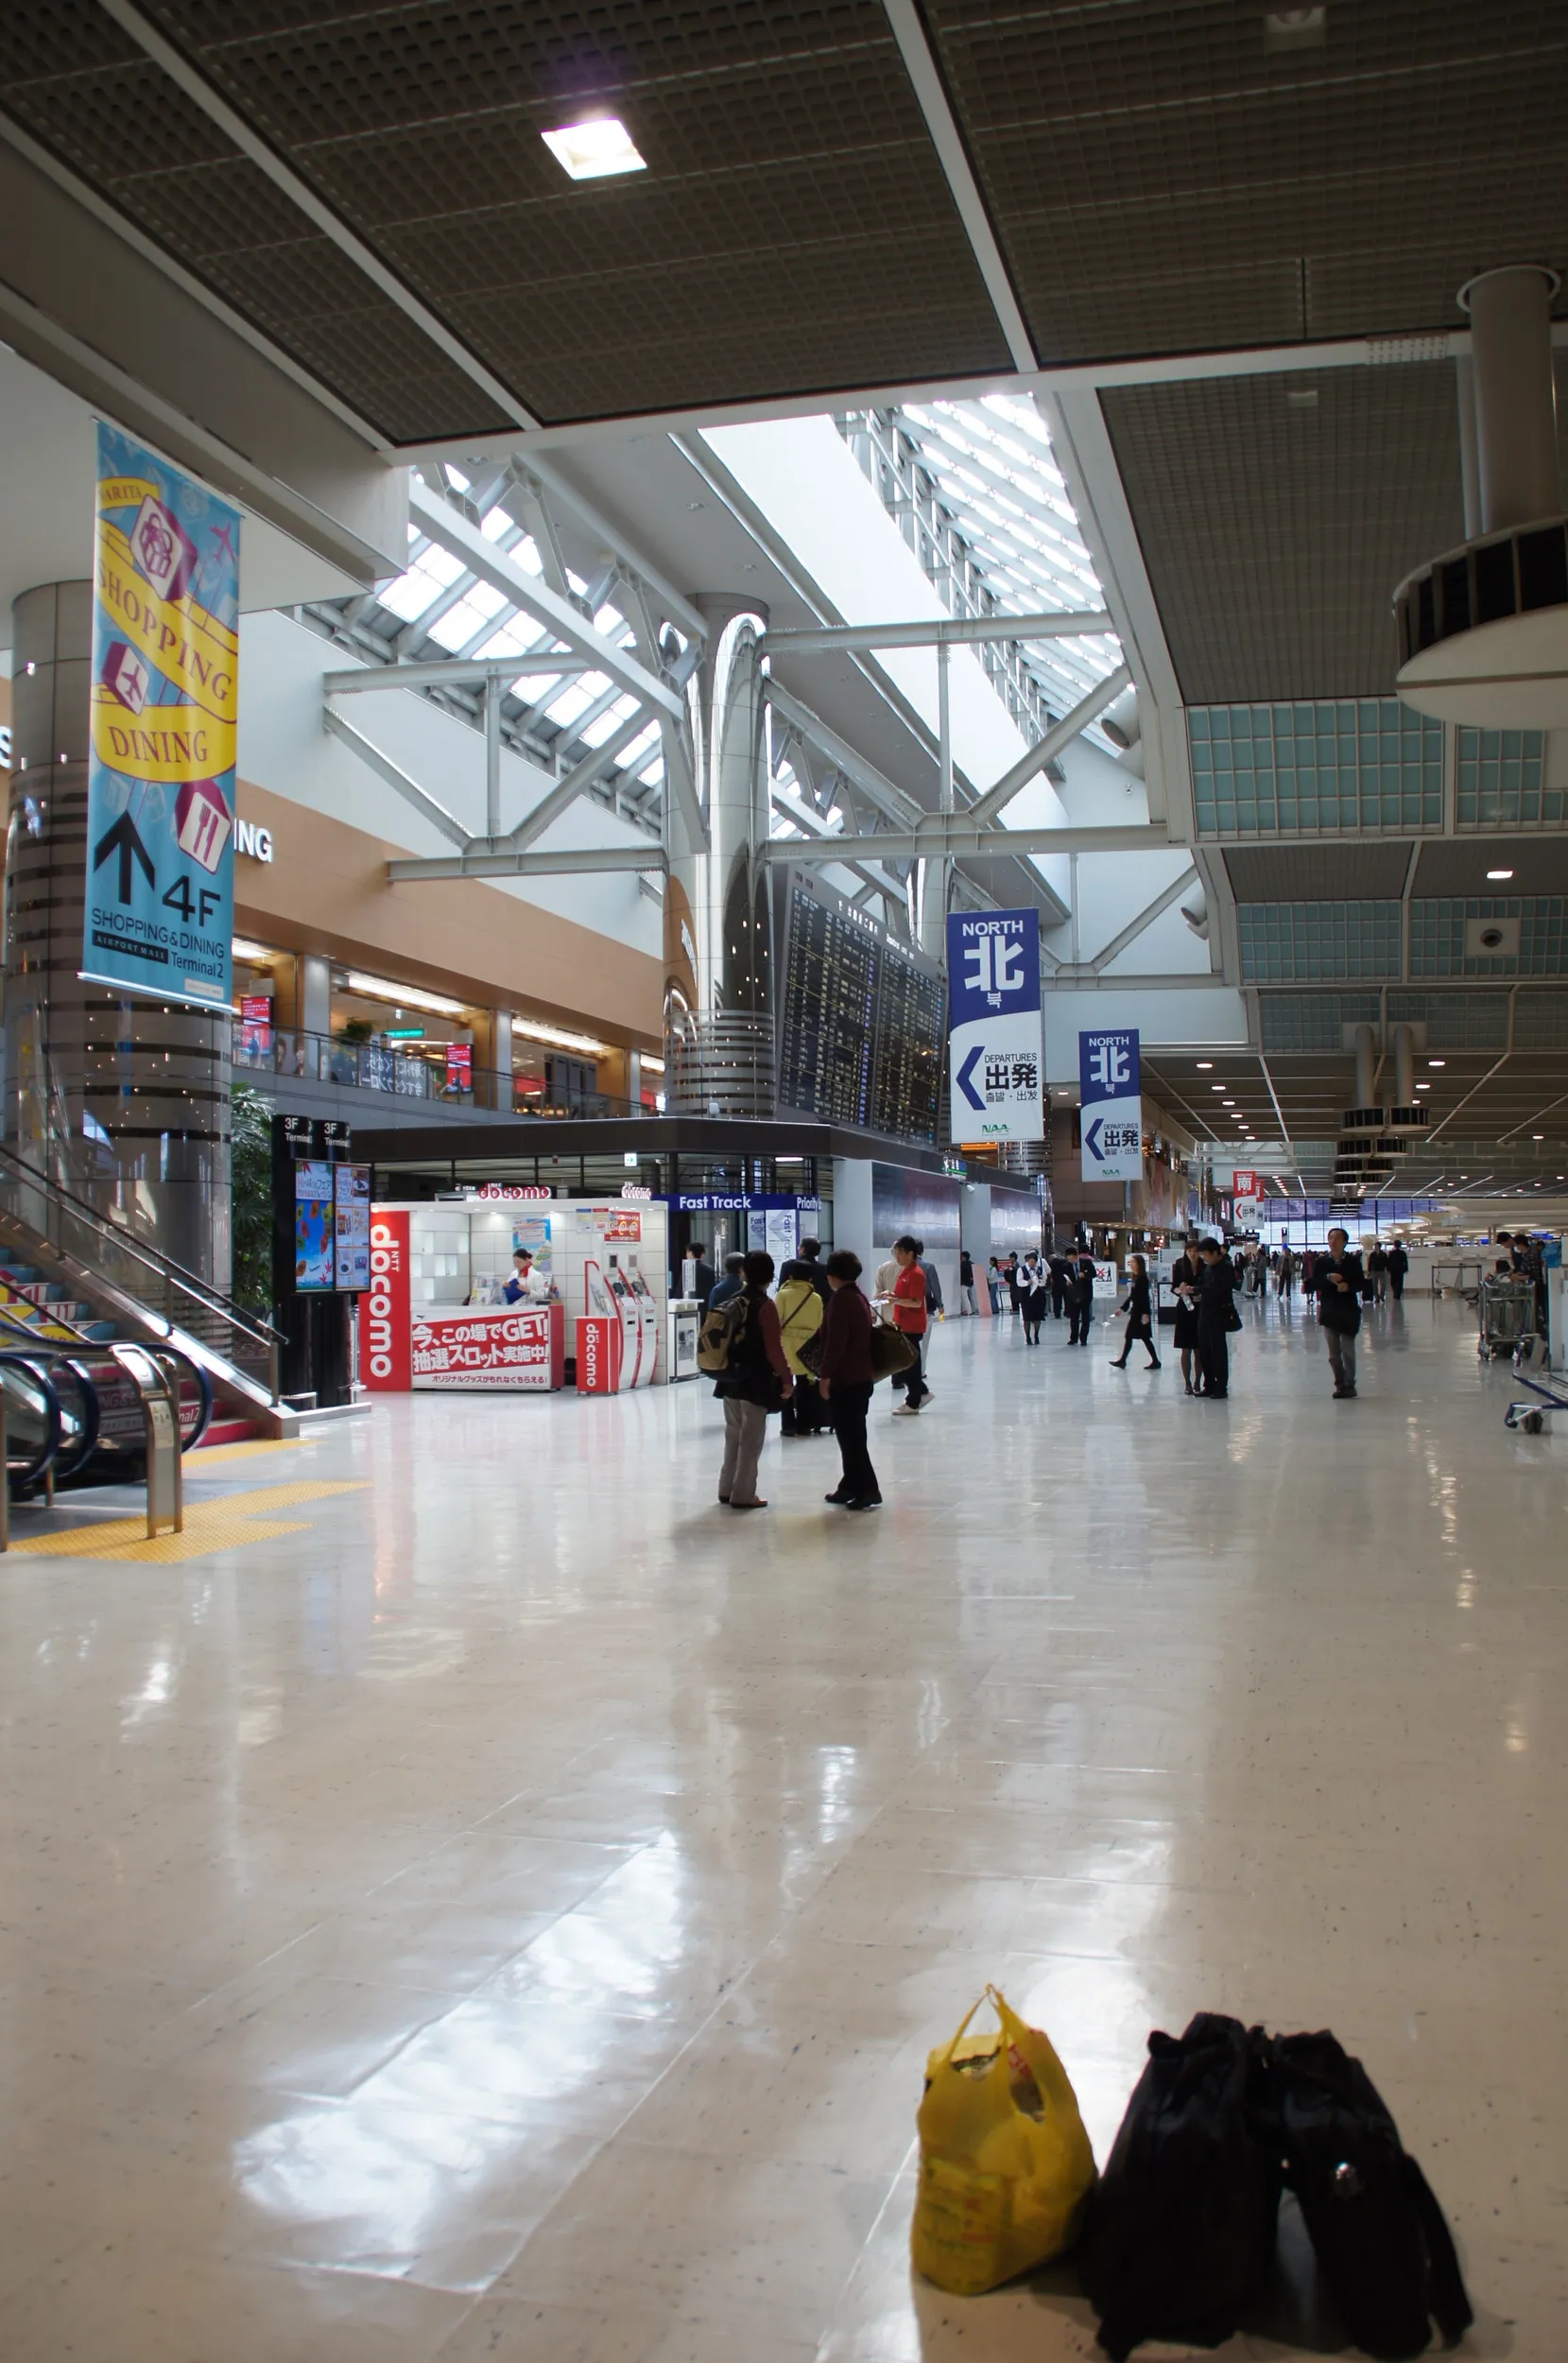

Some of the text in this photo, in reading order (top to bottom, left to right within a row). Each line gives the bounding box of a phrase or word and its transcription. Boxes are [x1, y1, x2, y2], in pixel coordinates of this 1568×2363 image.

[107, 725, 208, 764] DINING
[162, 874, 221, 927] 4F
[962, 920, 1024, 937] NORTH
[95, 935, 165, 960] AIRPORT MALL
[964, 935, 1025, 992] 北
[987, 991, 1002, 1009] 북
[1089, 1036, 1129, 1046] NORTH
[984, 1053, 1038, 1063] DEPARTURES
[1090, 1046, 1130, 1083] 北
[986, 1062, 1038, 1091] 出発
[284, 1117, 299, 1130] 3F
[324, 1122, 337, 1135] 3F
[982, 1124, 1010, 1133] NAA
[1104, 1130, 1139, 1147] 出発
[478, 1183, 552, 1200] docomo
[1237, 1177, 1252, 1191] 南
[680, 1196, 708, 1210] Fast
[712, 1196, 752, 1210] Track
[391, 1250, 400, 1272] NTT
[370, 1224, 400, 1378] docomo
[412, 1313, 549, 1349] 今、この場でGET!
[412, 1343, 549, 1372] 抽選スロット実施中!
[586, 1323, 599, 1387] docomo
